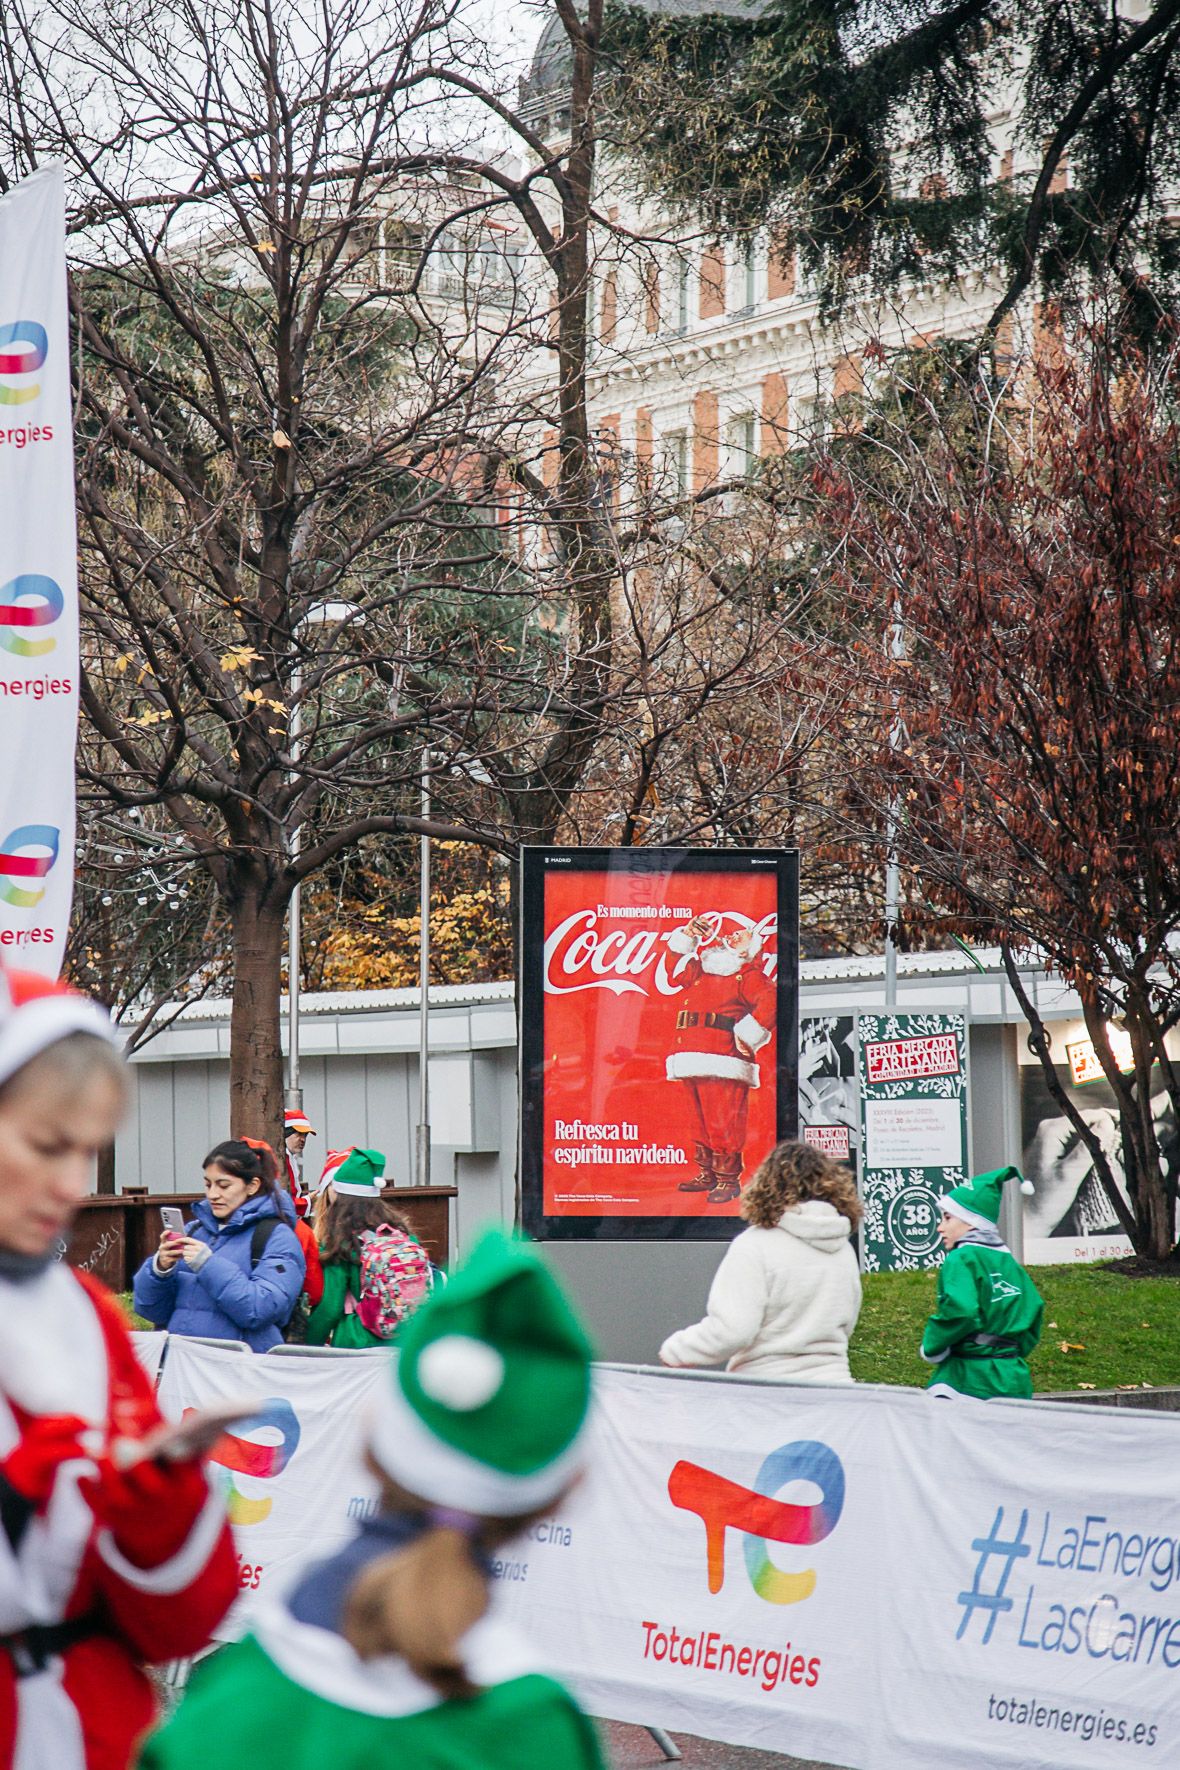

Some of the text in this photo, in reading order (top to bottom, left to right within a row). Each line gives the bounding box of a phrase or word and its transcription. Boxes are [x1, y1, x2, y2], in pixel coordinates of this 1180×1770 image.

[597, 904, 692, 918] Es momento de una
[901, 1037, 953, 1054] MERCADO
[554, 1119, 639, 1141] Refresca tu
[554, 1143, 689, 1169] espíritu navideño.
[903, 1204, 931, 1225] 38
[906, 1226, 929, 1236] AÑOS
[1075, 1247, 1089, 1257] Del
[1100, 1246, 1107, 1256] al
[1110, 1246, 1121, 1256] 30
[1123, 1247, 1134, 1255] de
[642, 1620, 822, 1692] TotalEnergies
[988, 1693, 1159, 1746] totalenergies.es
